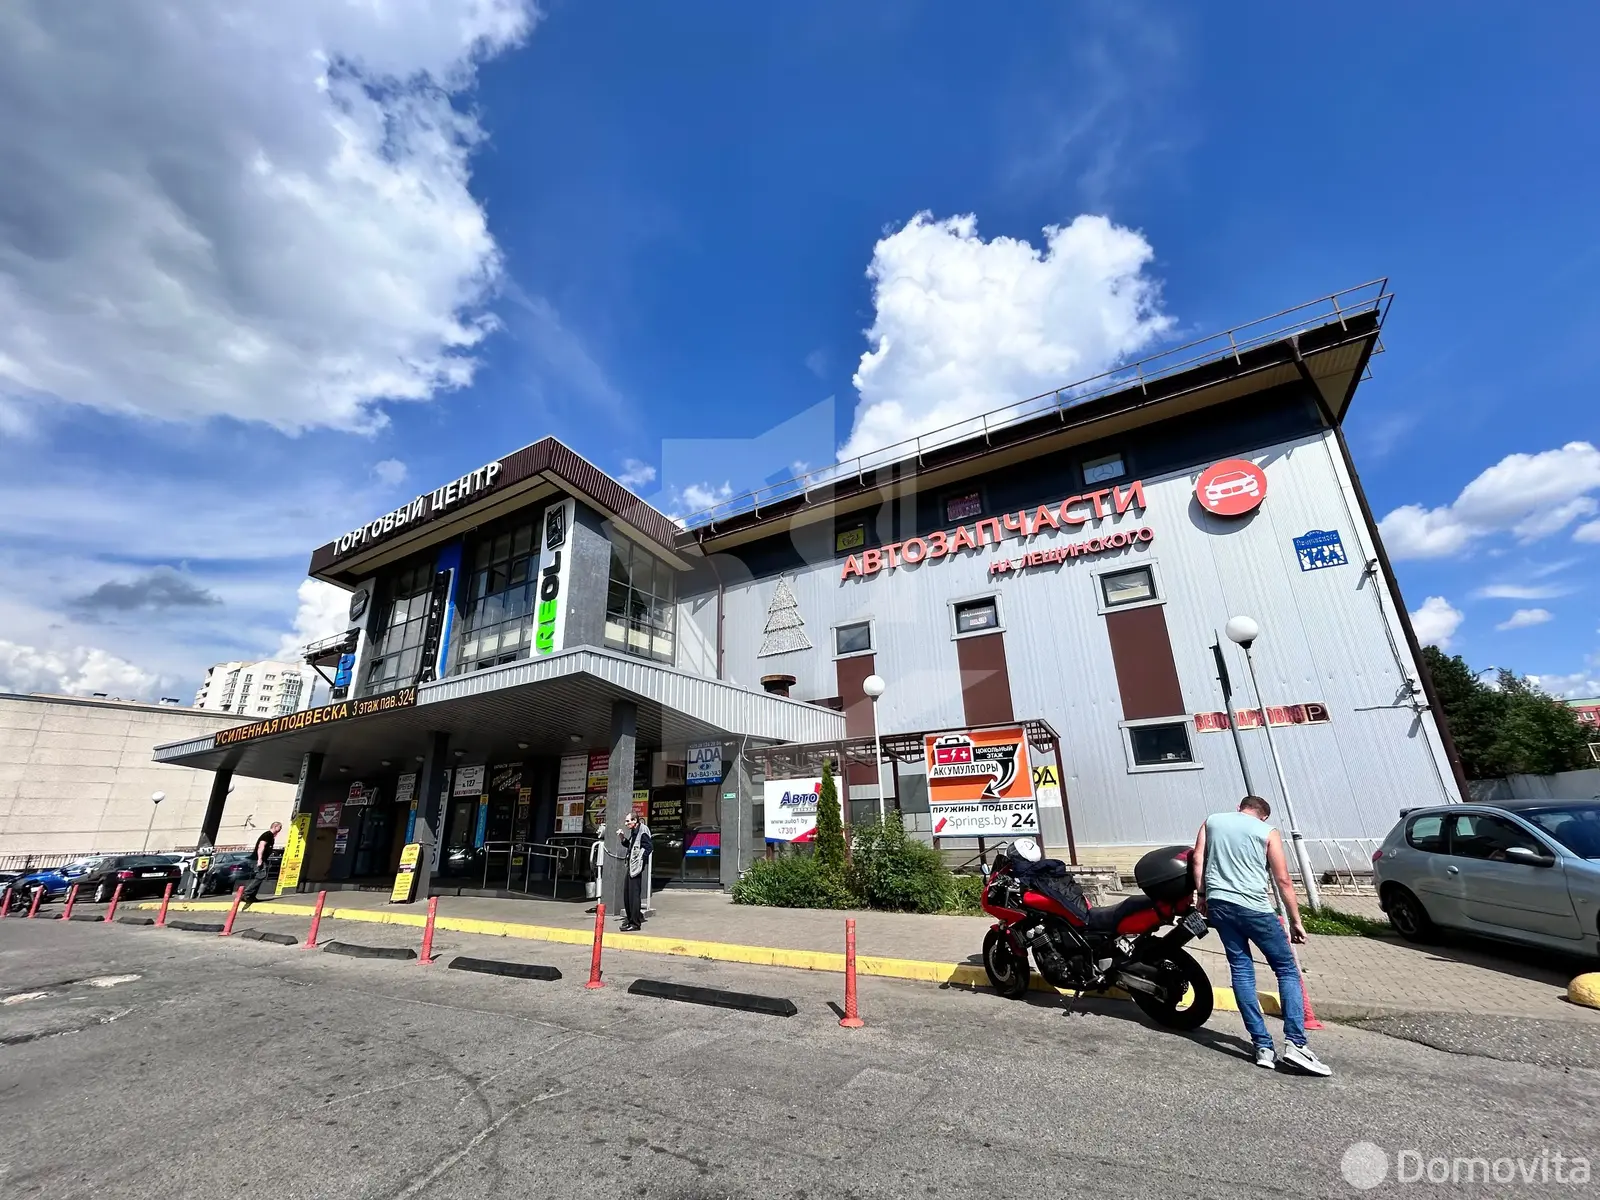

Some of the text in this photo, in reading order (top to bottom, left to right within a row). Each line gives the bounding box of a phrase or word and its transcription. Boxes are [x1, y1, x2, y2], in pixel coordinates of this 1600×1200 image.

[333, 461, 502, 556] ТОРГОВЫЙ ЦЕНТР
[840, 480, 1147, 581] АВТОЗАПЧАСТИ
[989, 526, 1154, 575] НА ЛЕЩИНСКОГО
[214, 718, 279, 747] УСИЛЕННАЯ
[279, 702, 348, 733] ПОДВЕСКА
[352, 700, 358, 716] 3
[359, 698, 379, 715] этаж
[687, 747, 722, 764] LADA
[975, 744, 1014, 754] ЦОКОЛЬНЫЙ
[932, 802, 1034, 814] ПРУЖИНЫ ПОДВЕСКИ
[948, 813, 1008, 829] Springs.by
[1011, 812, 1036, 828] 24
